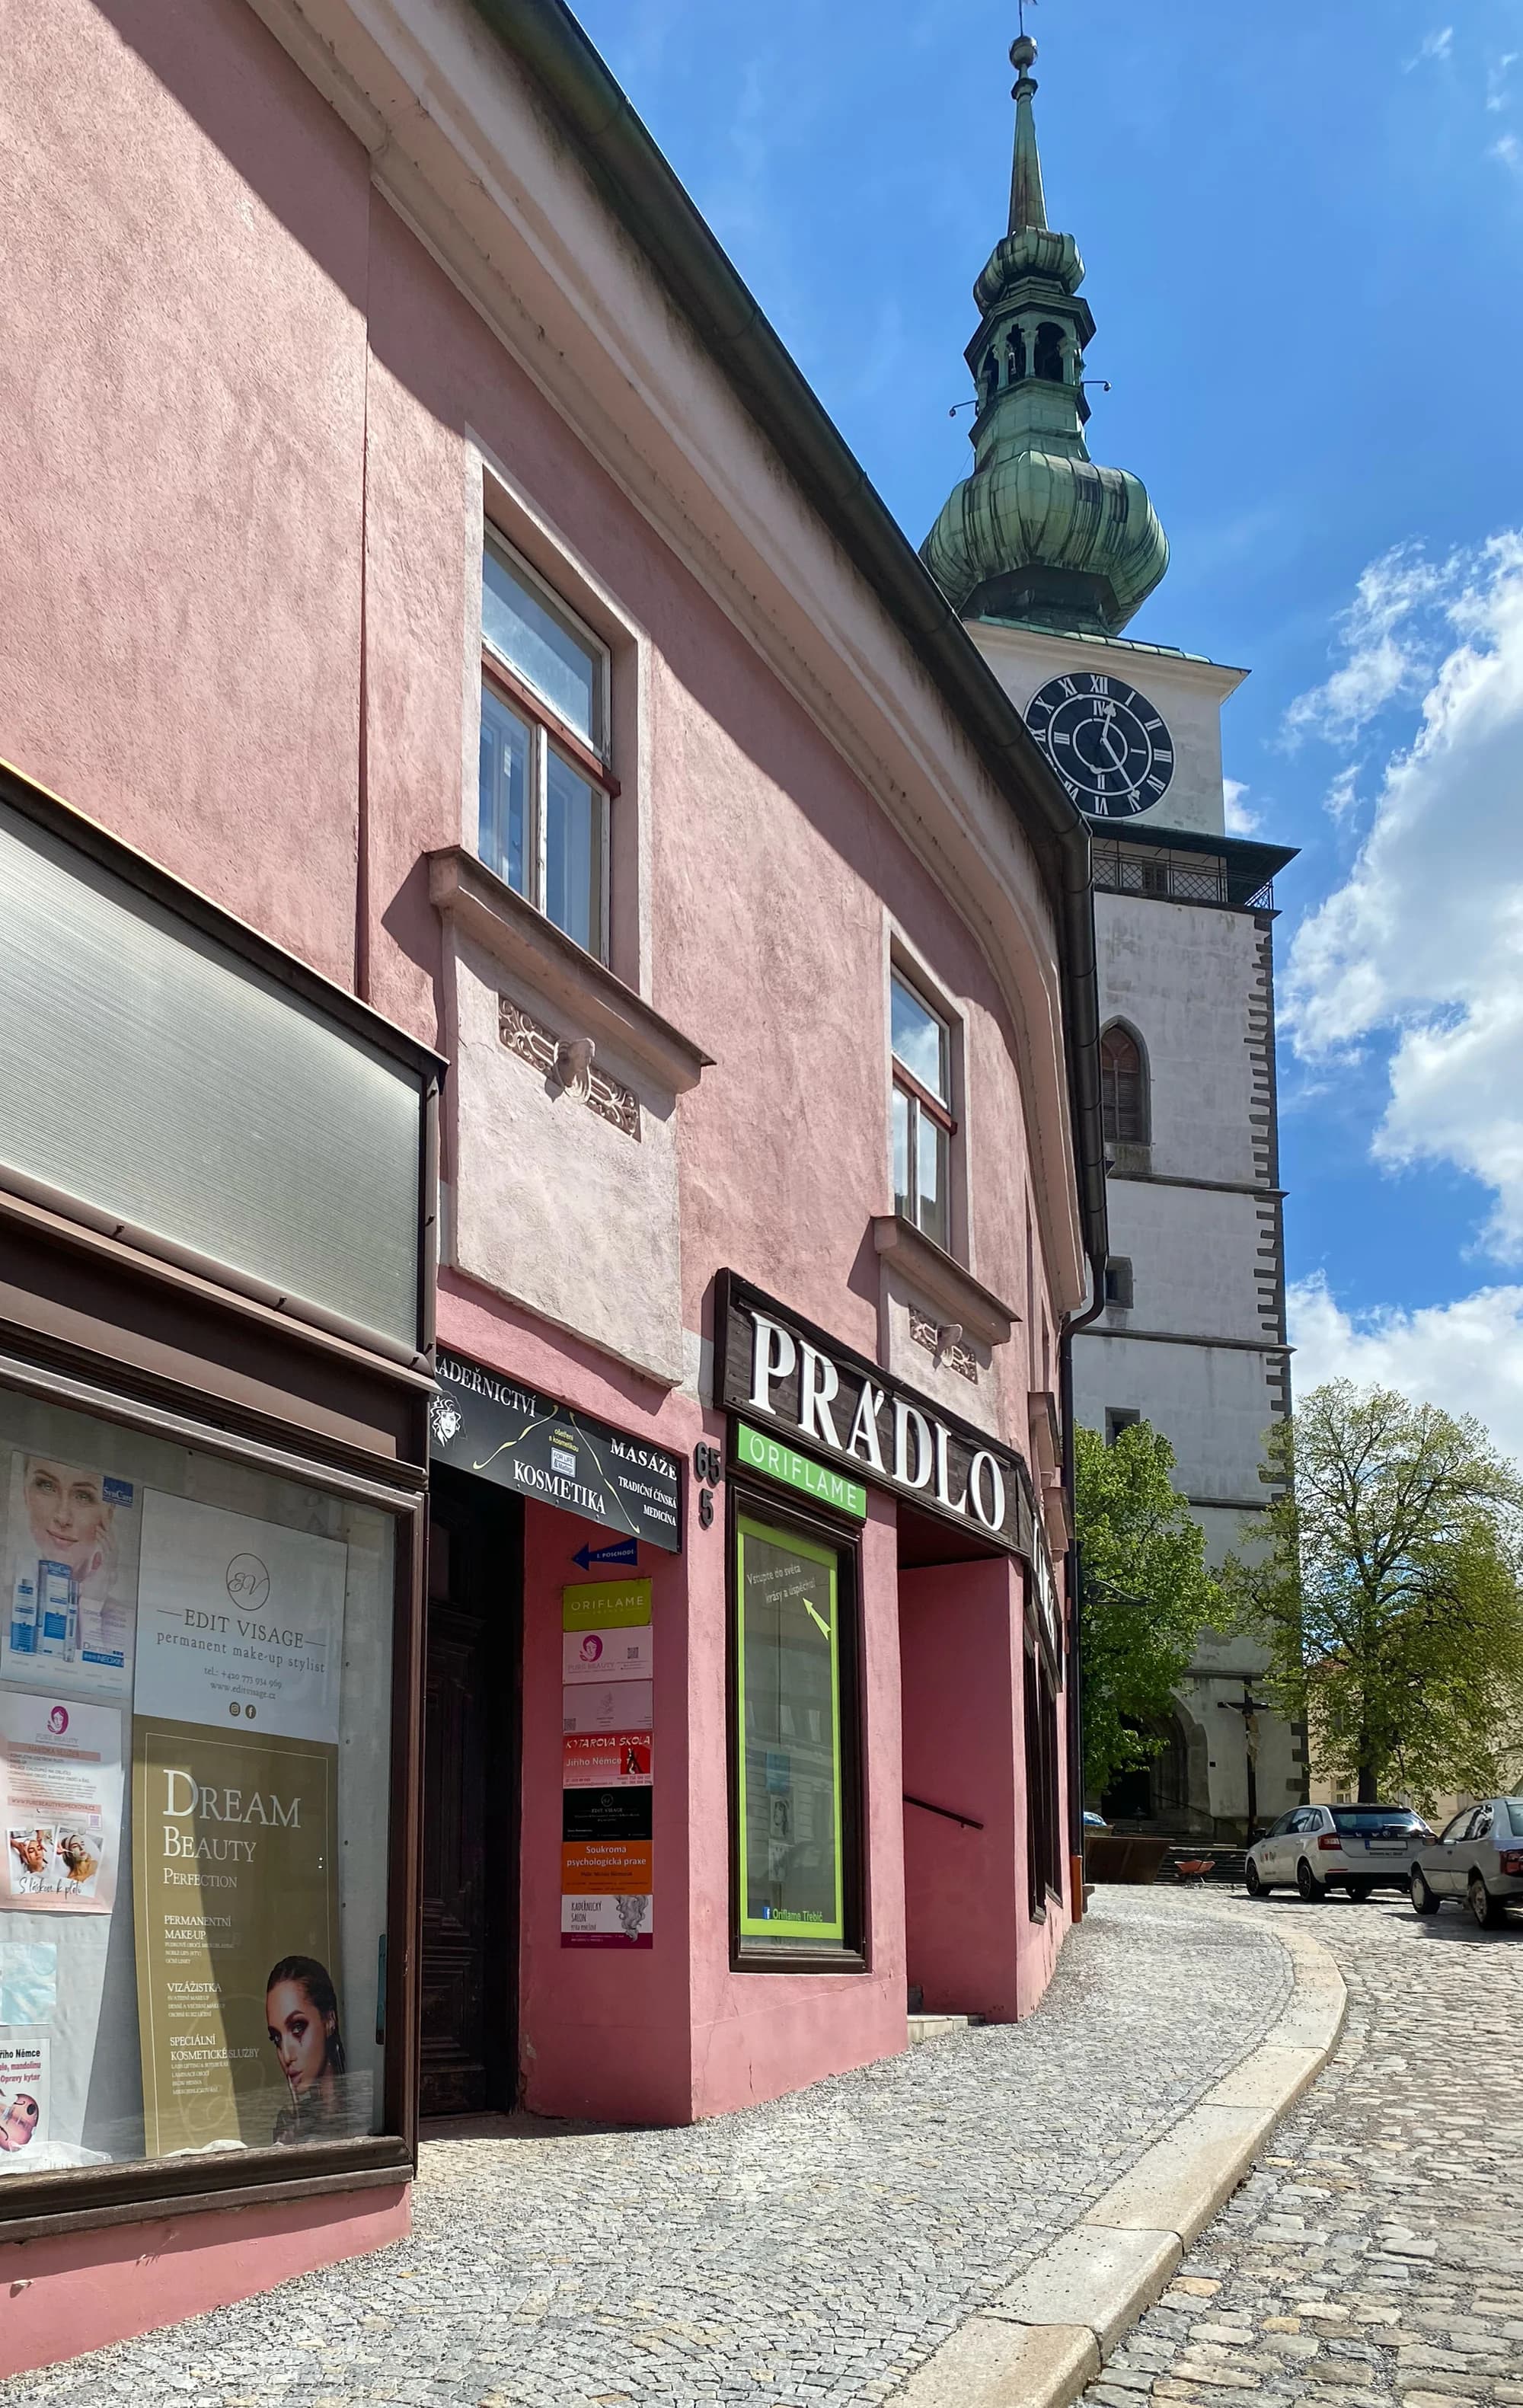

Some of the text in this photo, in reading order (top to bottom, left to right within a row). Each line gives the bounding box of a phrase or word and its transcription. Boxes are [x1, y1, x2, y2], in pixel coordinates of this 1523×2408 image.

[1057, 676, 1078, 698] XI
[1090, 674, 1109, 695] XII
[749, 1311, 1005, 1531] PRÁDLO
[609, 1437, 677, 1481] MASÁŽE
[695, 1442, 721, 1485] 65
[750, 1434, 857, 1509] ORIFLAME
[512, 1458, 606, 1515] KOSMETIKA
[618, 1476, 677, 1509] TRADIČNÍ ČÍNSKÁ
[643, 1504, 677, 1526] MEDICÍNA
[699, 1488, 714, 1527] 5
[571, 1595, 644, 1611] ORIFLAME
[184, 1609, 304, 1649] EDIT VISAGE
[156, 1631, 326, 1673] permanent make-up stylist
[162, 1768, 302, 1828] DREAM
[162, 1825, 257, 1863] BEAUTY
[624, 1858, 647, 1867] praxe
[162, 1867, 238, 1889] PERFECTION
[164, 1915, 231, 1927] PERMANENTNÍ
[772, 1908, 802, 1921] Oriflame
[167, 1980, 222, 1993] VIZÁŽISTKA
[170, 2033, 216, 2047] SPECIÁLNÍ
[16, 2049, 40, 2058] Němce
[171, 2046, 260, 2061] KOSMETICKÉ SLUŽBY
